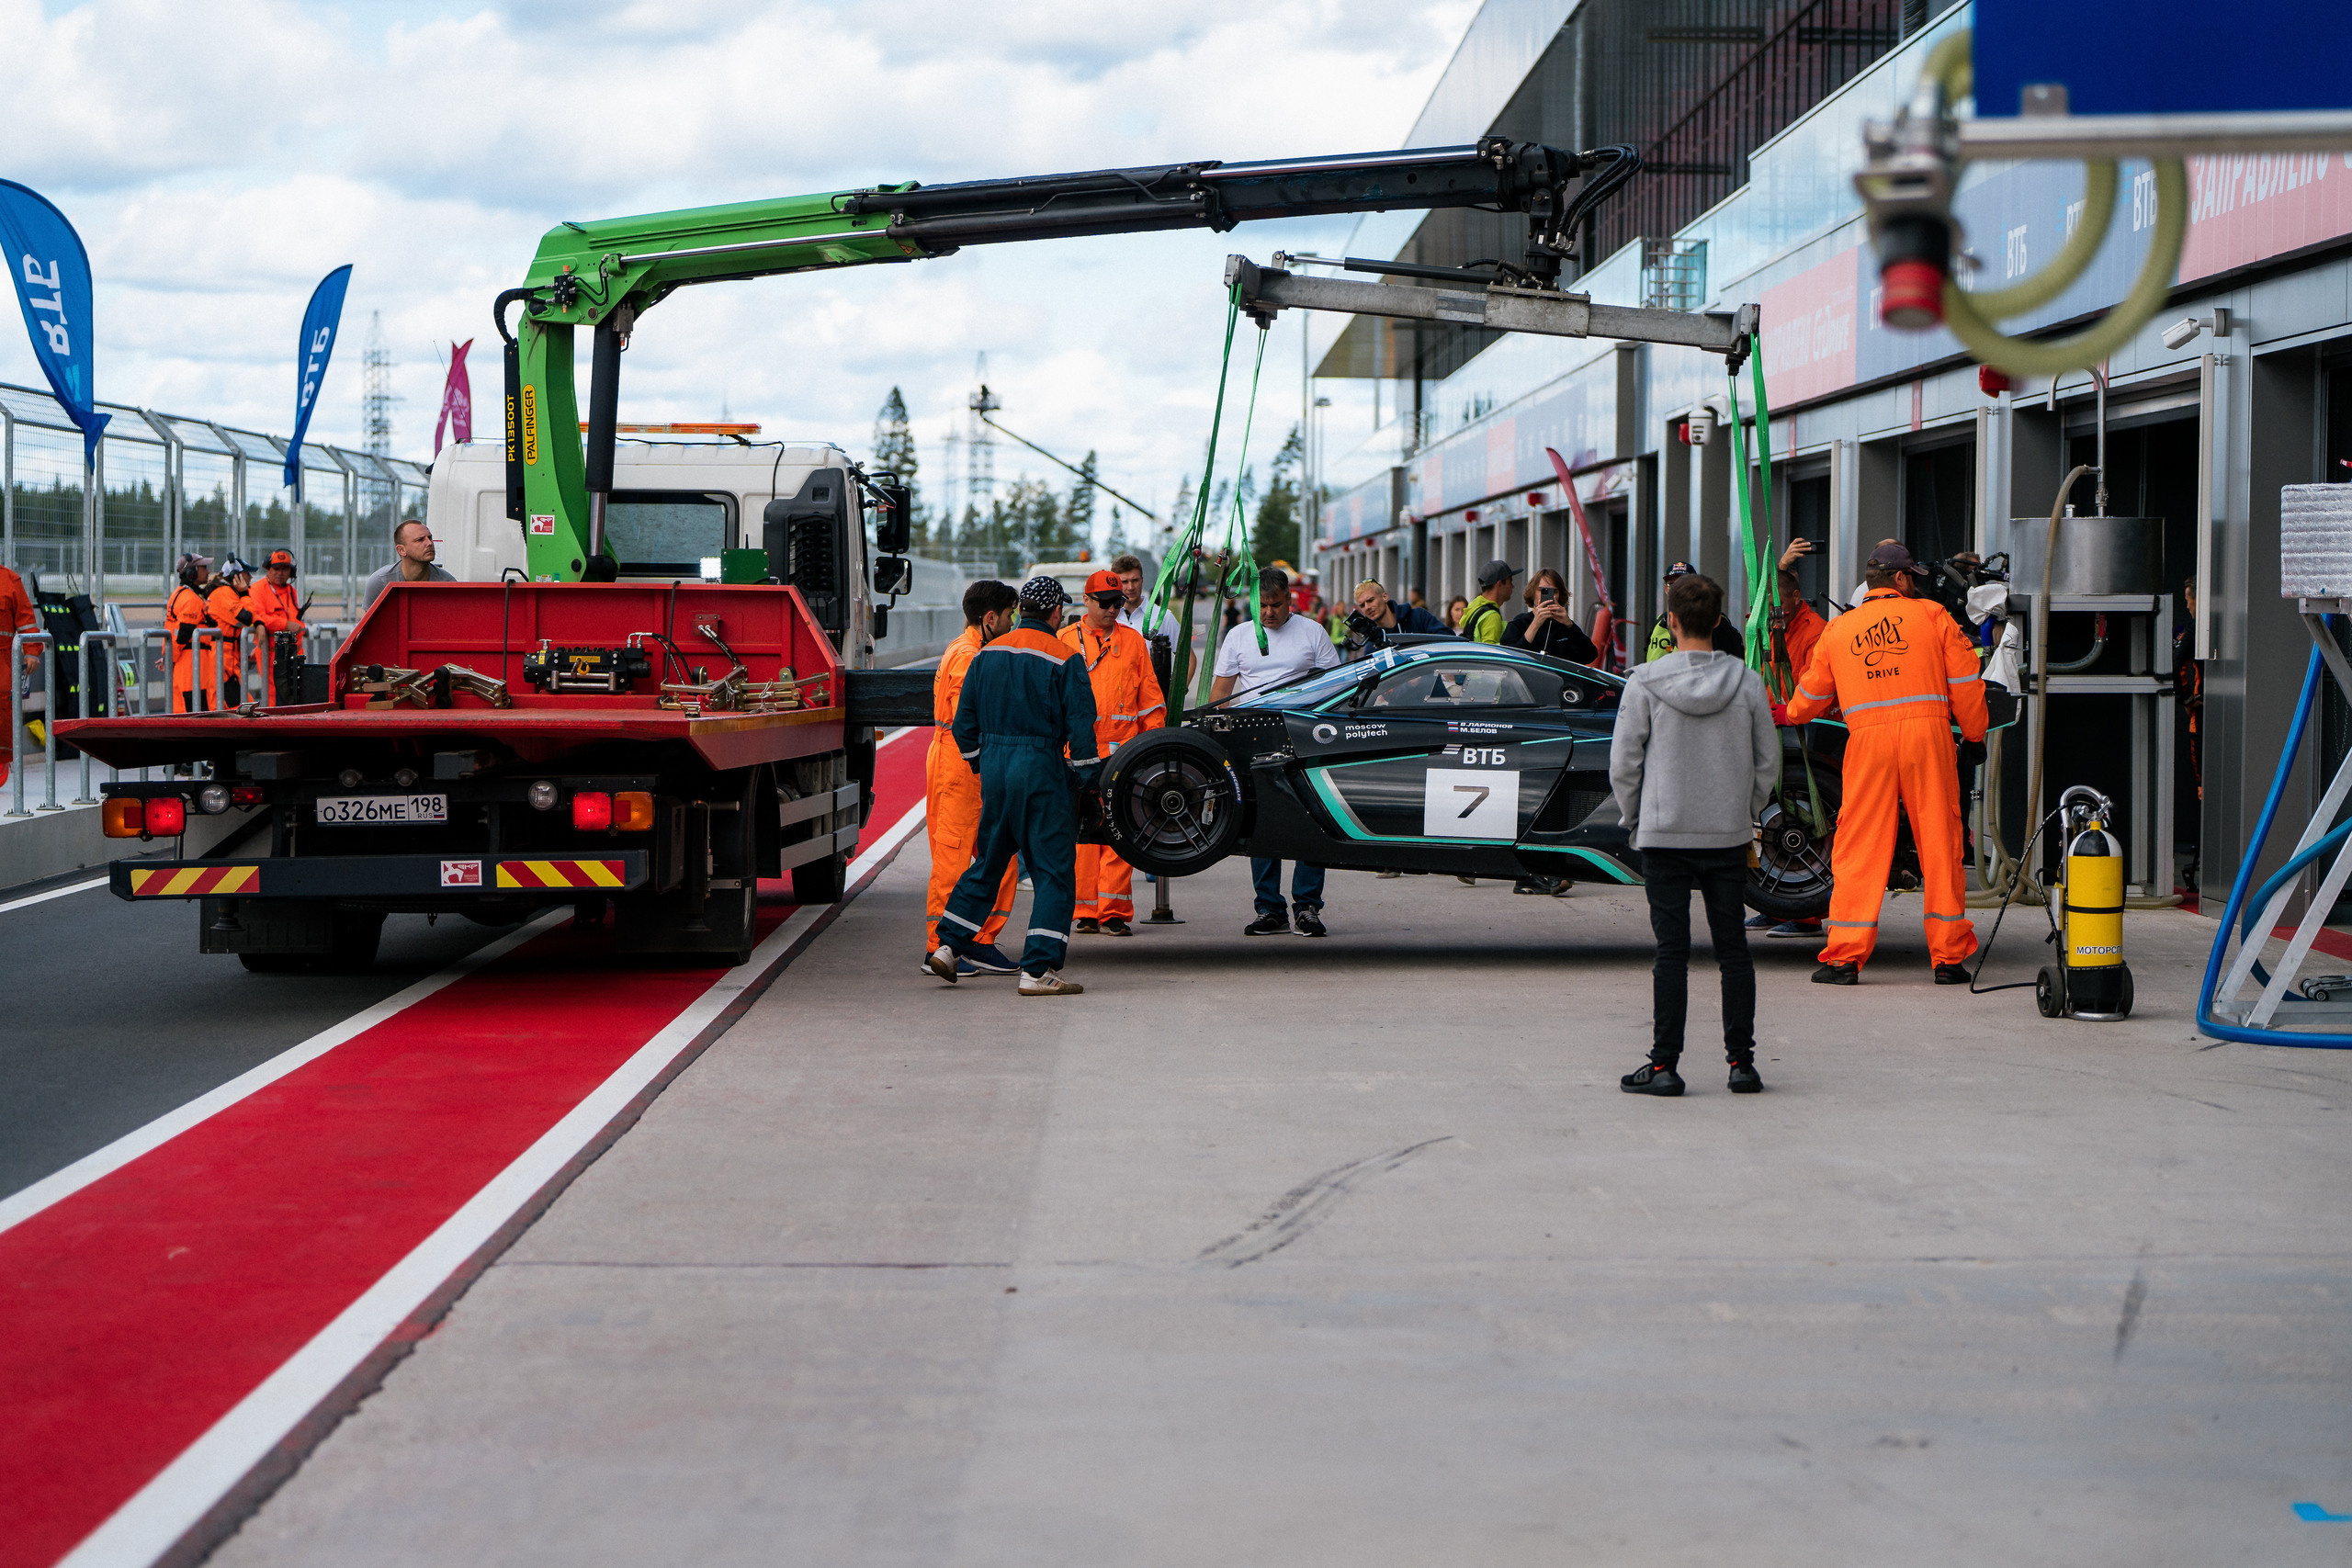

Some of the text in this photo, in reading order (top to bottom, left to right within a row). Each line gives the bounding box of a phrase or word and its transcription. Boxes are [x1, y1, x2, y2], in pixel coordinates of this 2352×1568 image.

[2066, 198, 2086, 245] ВТ
[2007, 224, 2027, 279] ВТБ
[300, 326, 330, 408] ВТБ
[525, 389, 536, 460] PALFINGER
[1867, 667, 1900, 680] DRIVE
[1345, 729, 1388, 740] polytech
[1463, 747, 1506, 765] ВТБ
[410, 796, 442, 813] 198
[1453, 784, 1490, 818] 7
[2076, 945, 2123, 955] МОТОРСП
